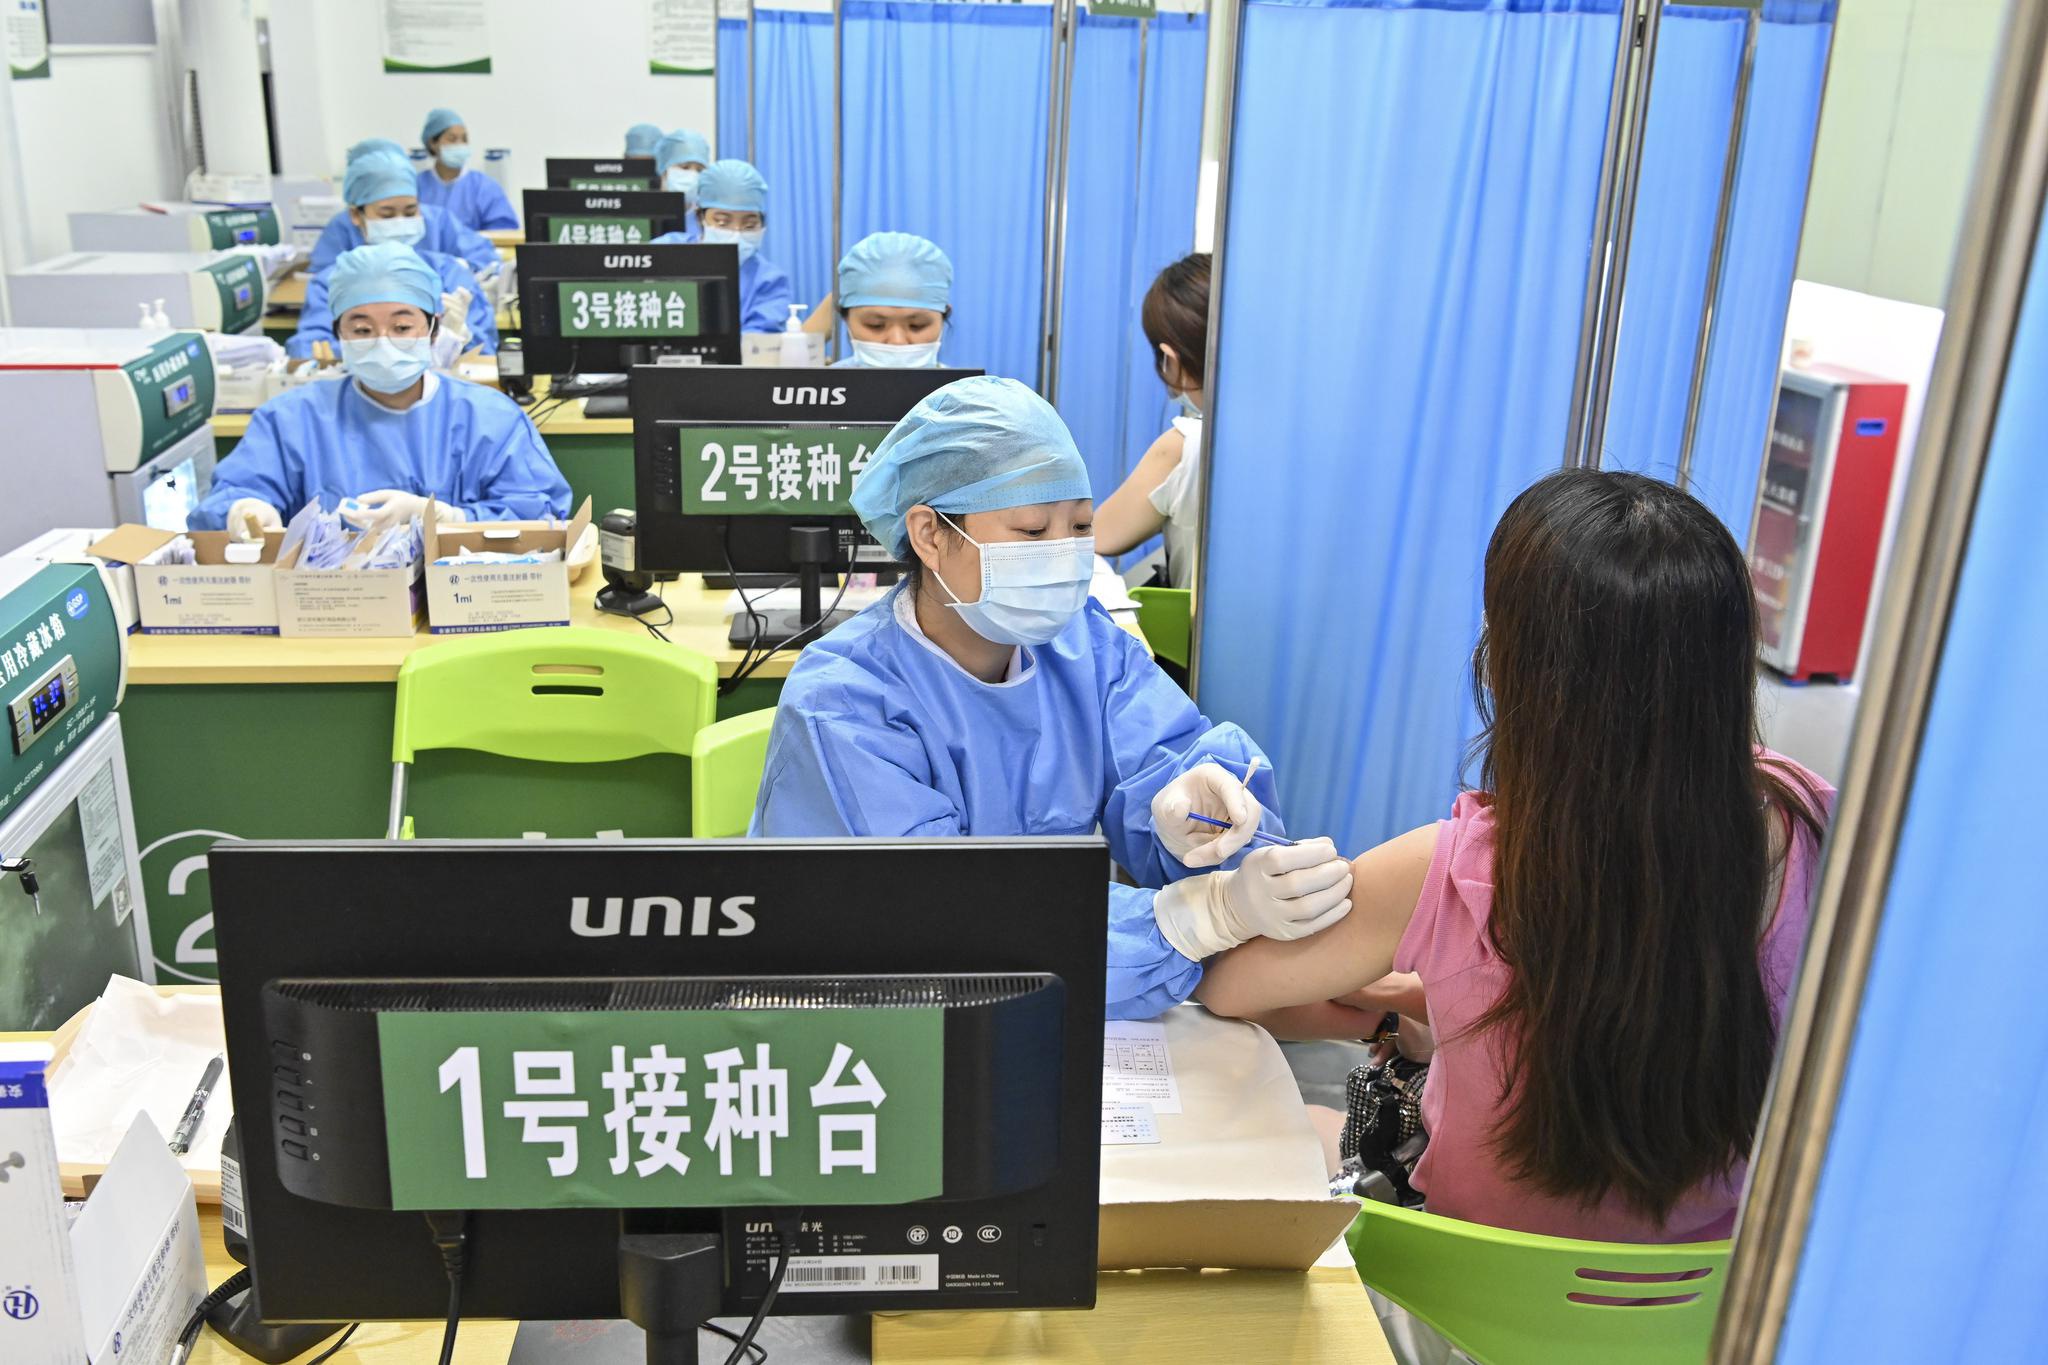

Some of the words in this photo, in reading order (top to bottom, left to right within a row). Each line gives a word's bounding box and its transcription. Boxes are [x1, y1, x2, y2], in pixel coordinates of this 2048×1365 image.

[585, 197, 622, 210] UNIS
[603, 254, 652, 269] UNIS
[572, 290, 686, 329] 3号接种台
[772, 386, 847, 406] UNIS
[452, 591, 473, 605] 1ml
[570, 895, 756, 937] UNIS
[438, 1042, 887, 1179] 1号接种台
